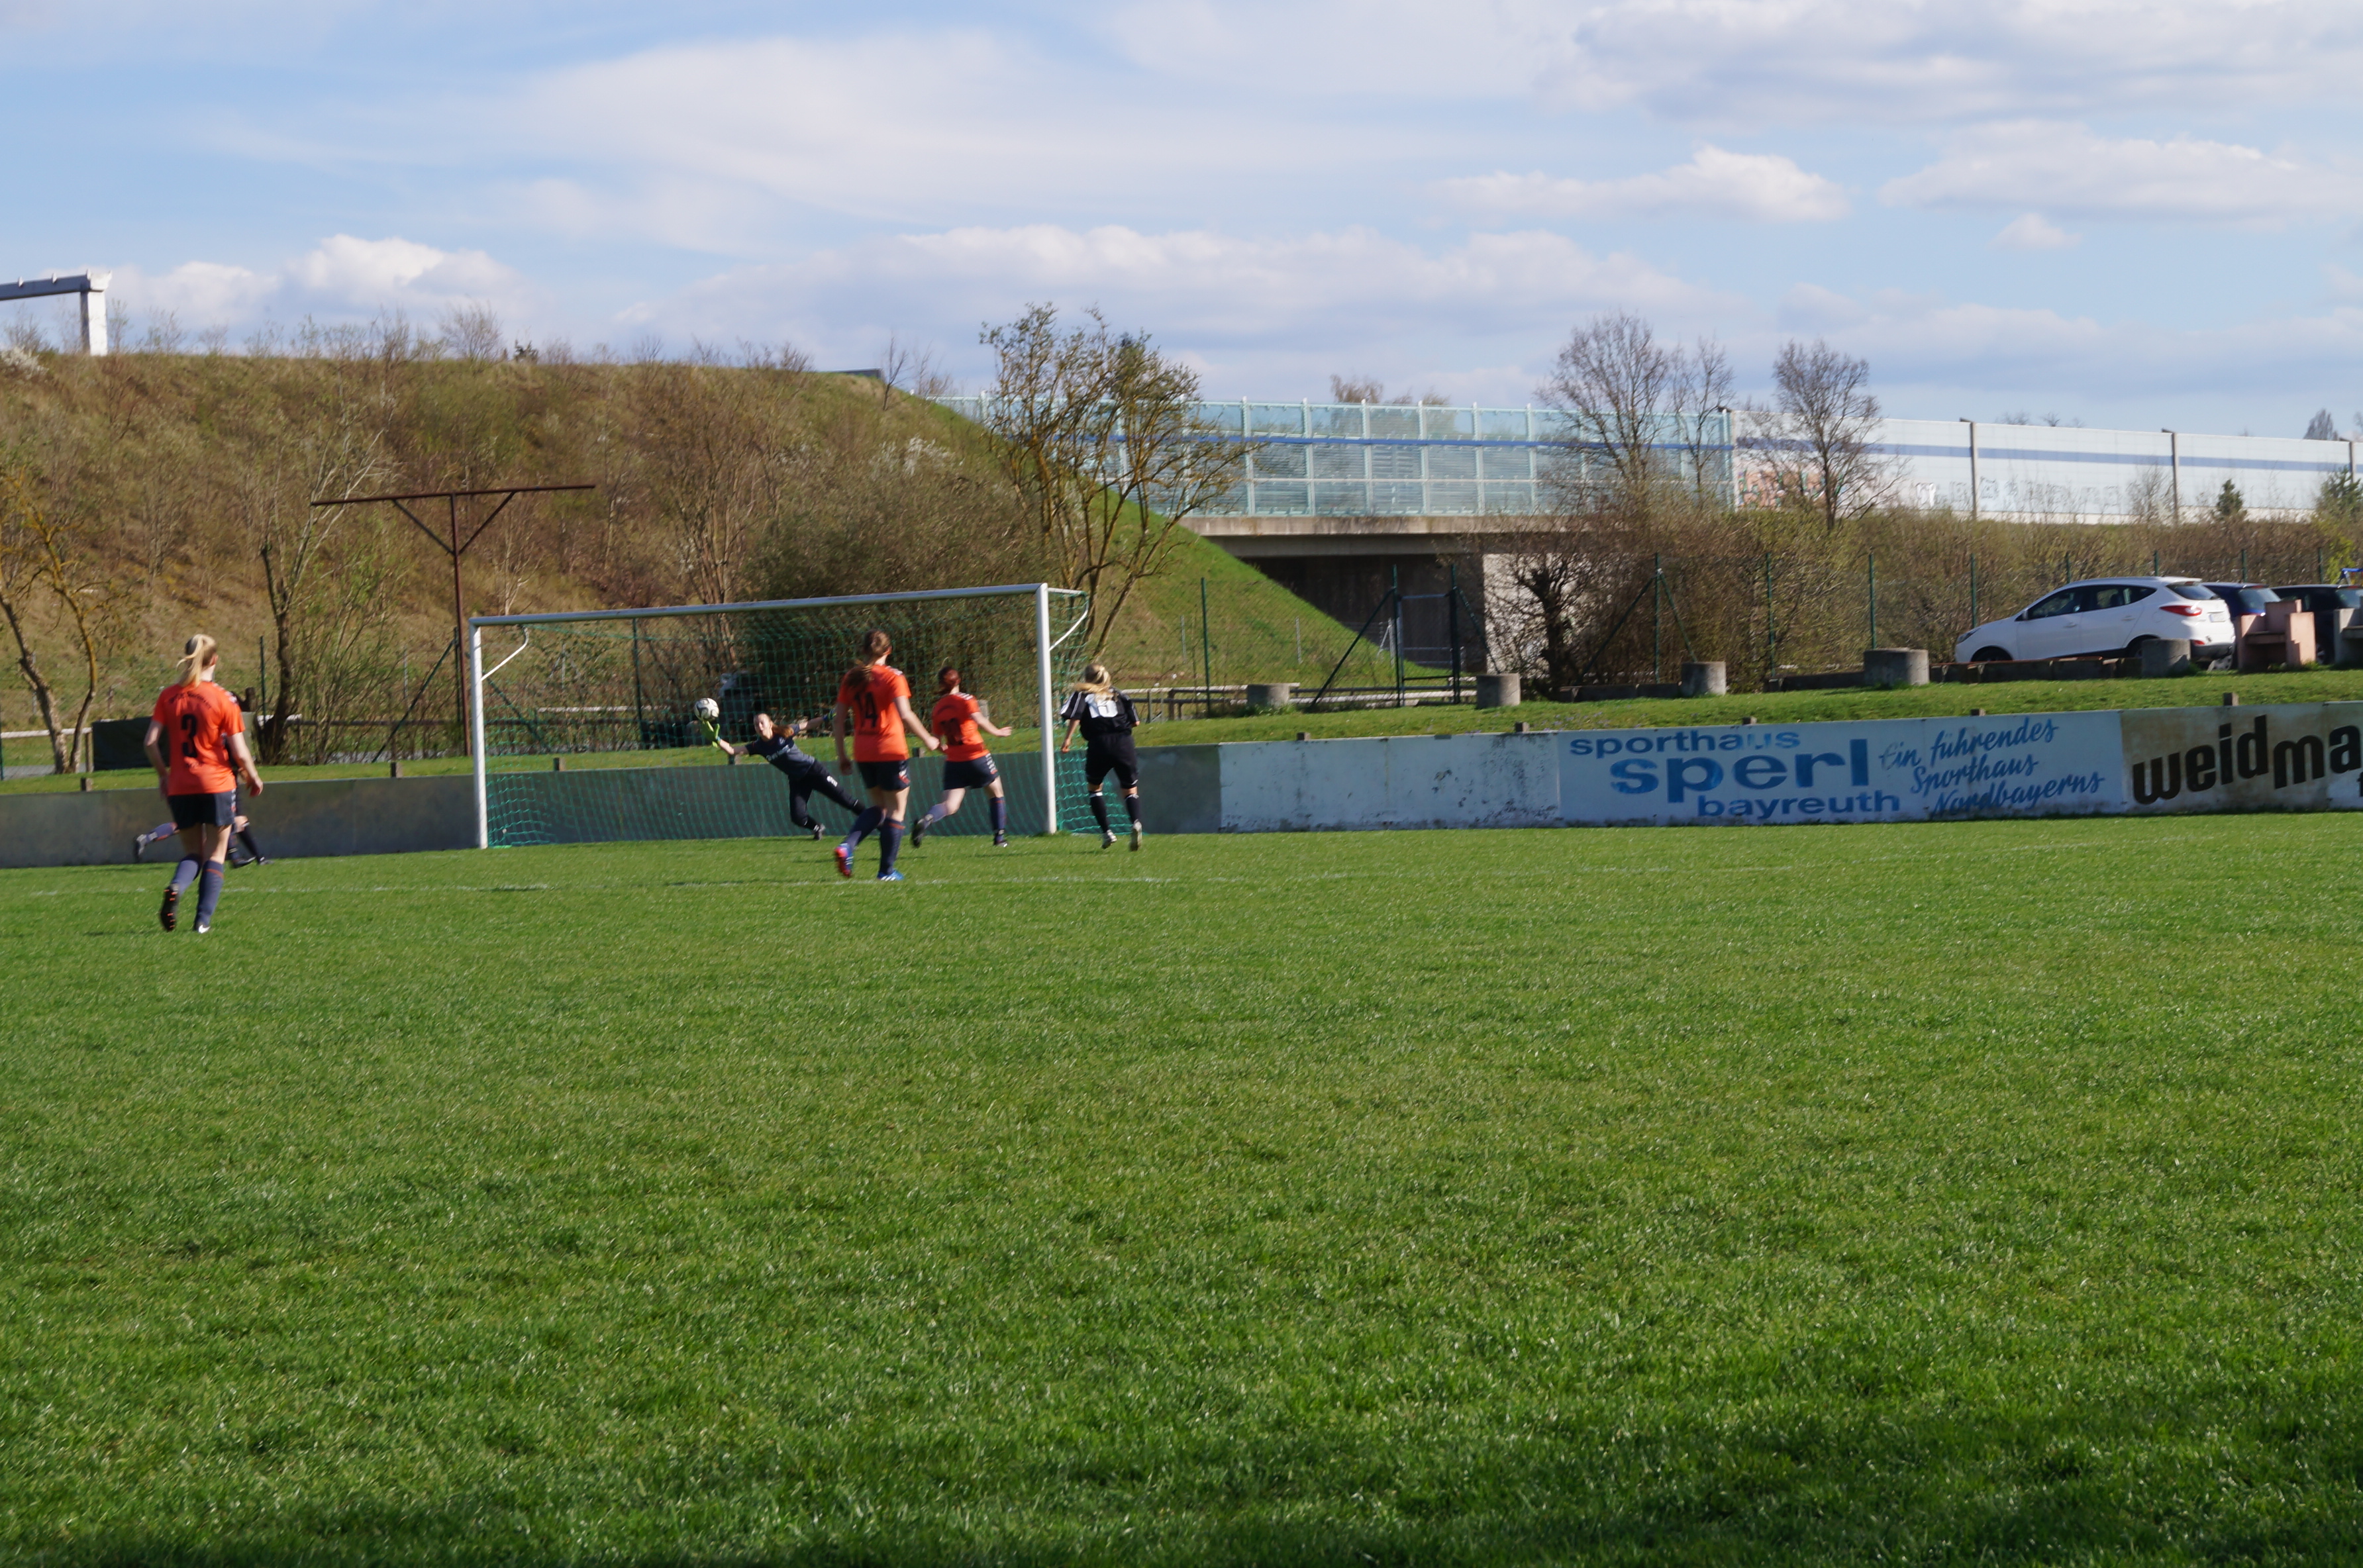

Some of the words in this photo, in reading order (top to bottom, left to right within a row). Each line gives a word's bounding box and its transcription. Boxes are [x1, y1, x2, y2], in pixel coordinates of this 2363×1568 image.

[854, 691, 878, 728] 14
[182, 714, 197, 758] 3
[1570, 730, 1801, 760] sporthaus
[1930, 716, 2059, 768] führendes
[1610, 738, 1869, 804] sperl
[1910, 754, 2039, 798] Sporthaus
[1697, 790, 1899, 820] bayreuth
[1927, 771, 2105, 819] Nordbayerns
